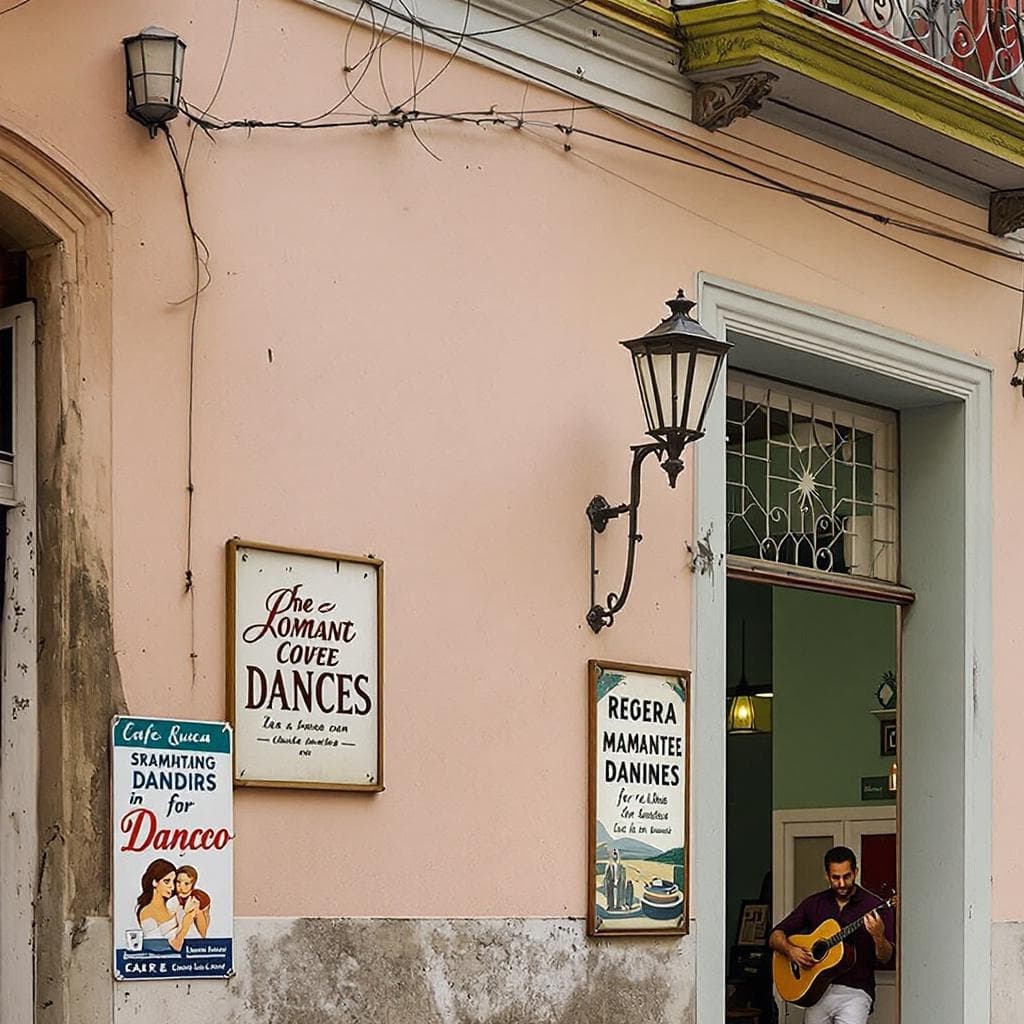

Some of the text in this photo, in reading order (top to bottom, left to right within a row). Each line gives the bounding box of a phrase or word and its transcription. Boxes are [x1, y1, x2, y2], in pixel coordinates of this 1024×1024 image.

[245, 665, 372, 715] DANCES
[608, 695, 677, 725] REGERA
[602, 731, 682, 757] MAMANTEE
[132, 771, 217, 791] DANDIRS
[605, 759, 680, 786] DANINES
[129, 792, 195, 817] in for
